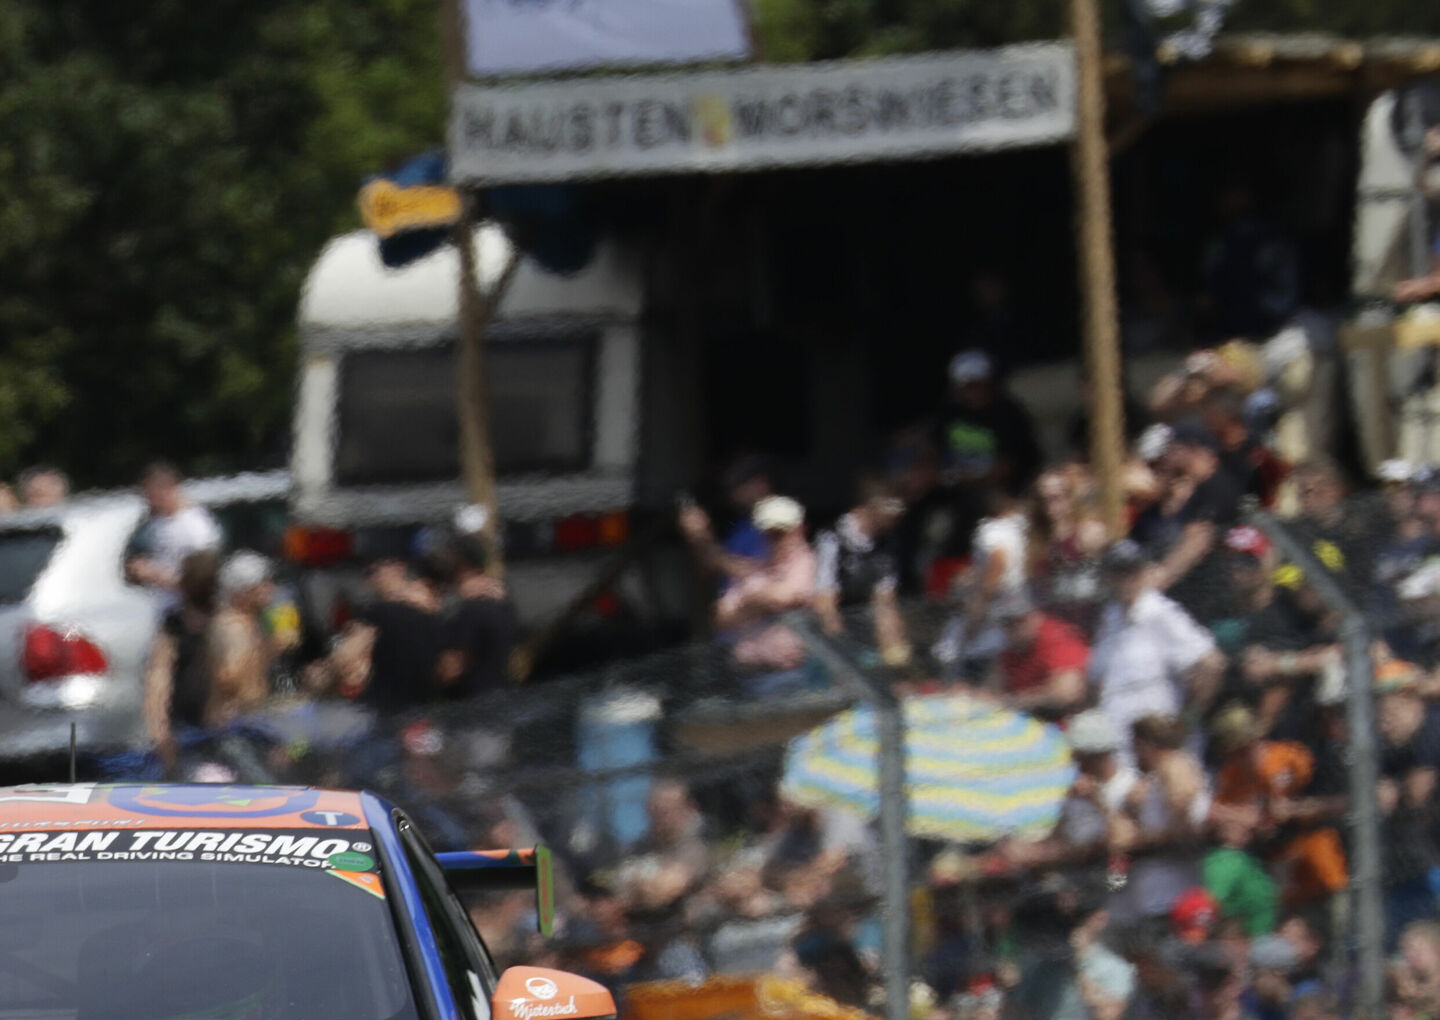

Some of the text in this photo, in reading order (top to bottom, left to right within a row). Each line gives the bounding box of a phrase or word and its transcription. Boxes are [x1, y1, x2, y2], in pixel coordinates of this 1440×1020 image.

[132, 831, 350, 859] TURISMO
[30, 852, 90, 862] REAL
[97, 851, 193, 861] DRIVING
